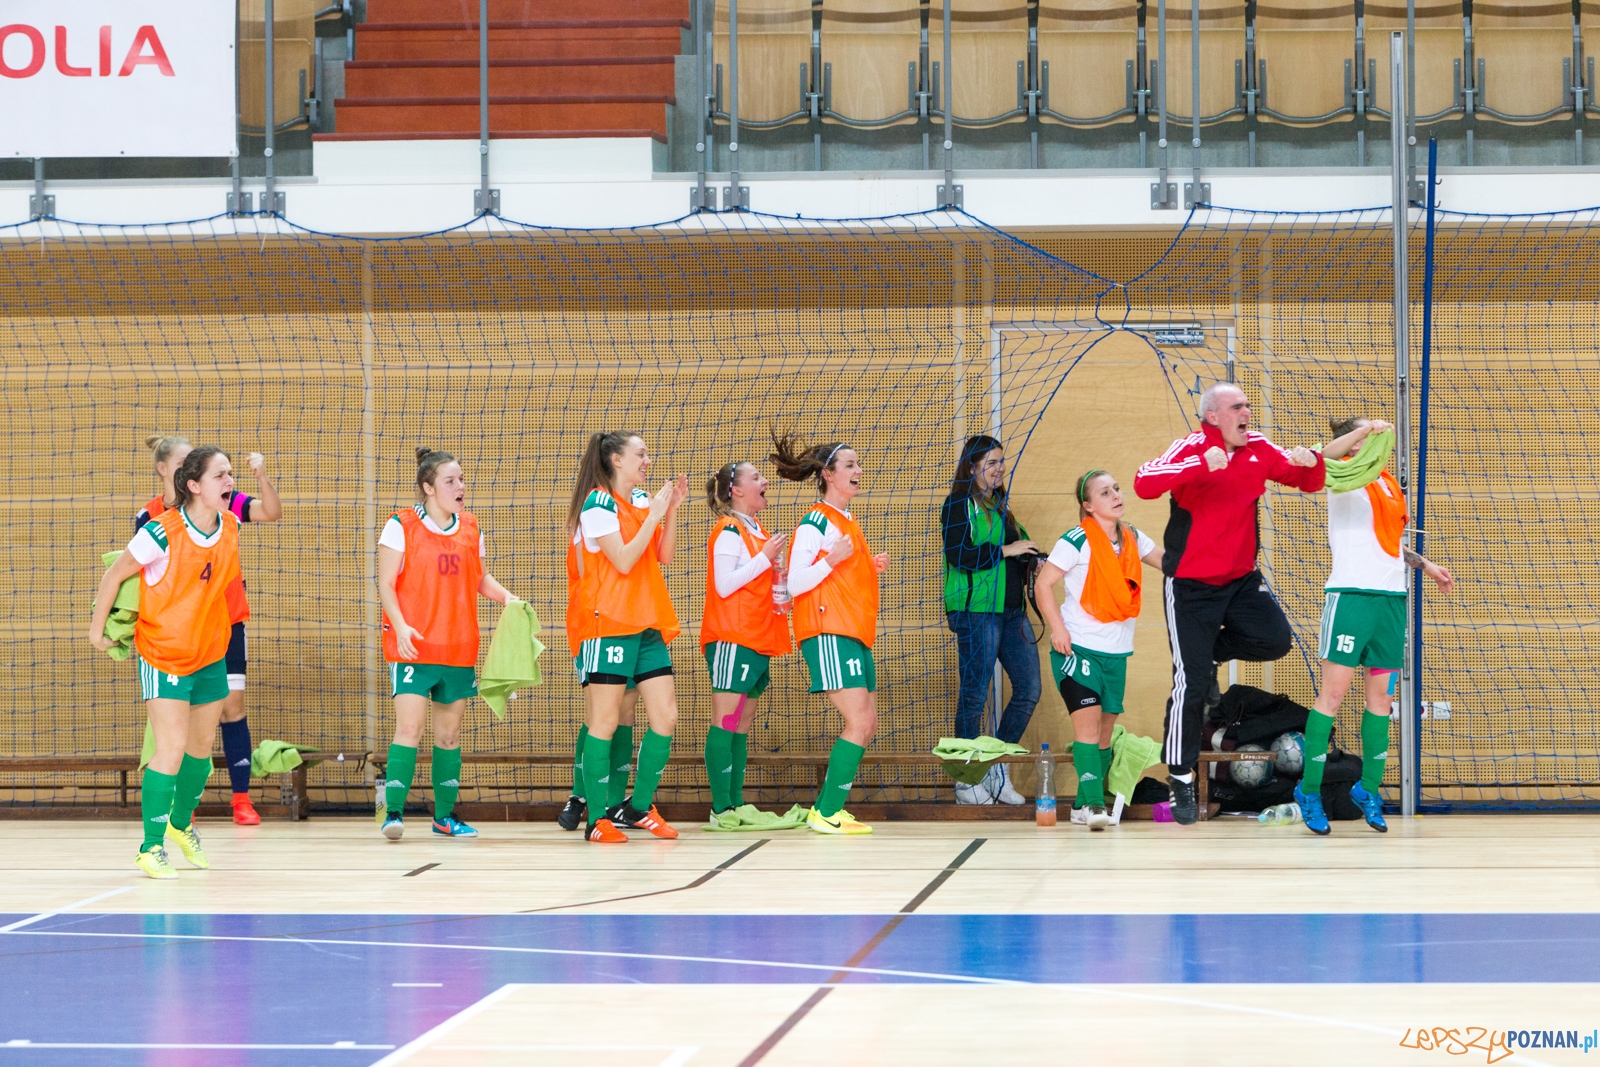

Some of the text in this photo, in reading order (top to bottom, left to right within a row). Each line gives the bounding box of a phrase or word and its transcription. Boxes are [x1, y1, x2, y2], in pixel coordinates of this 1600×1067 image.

[0, 23, 176, 79] OLIA
[199, 562, 212, 584] 4
[1336, 634, 1355, 654] 15
[605, 645, 624, 664] 13
[402, 665, 415, 684] 2
[740, 663, 750, 682] 7
[845, 658, 863, 677] 11
[1081, 659, 1091, 676] 6
[166, 673, 179, 686] 4
